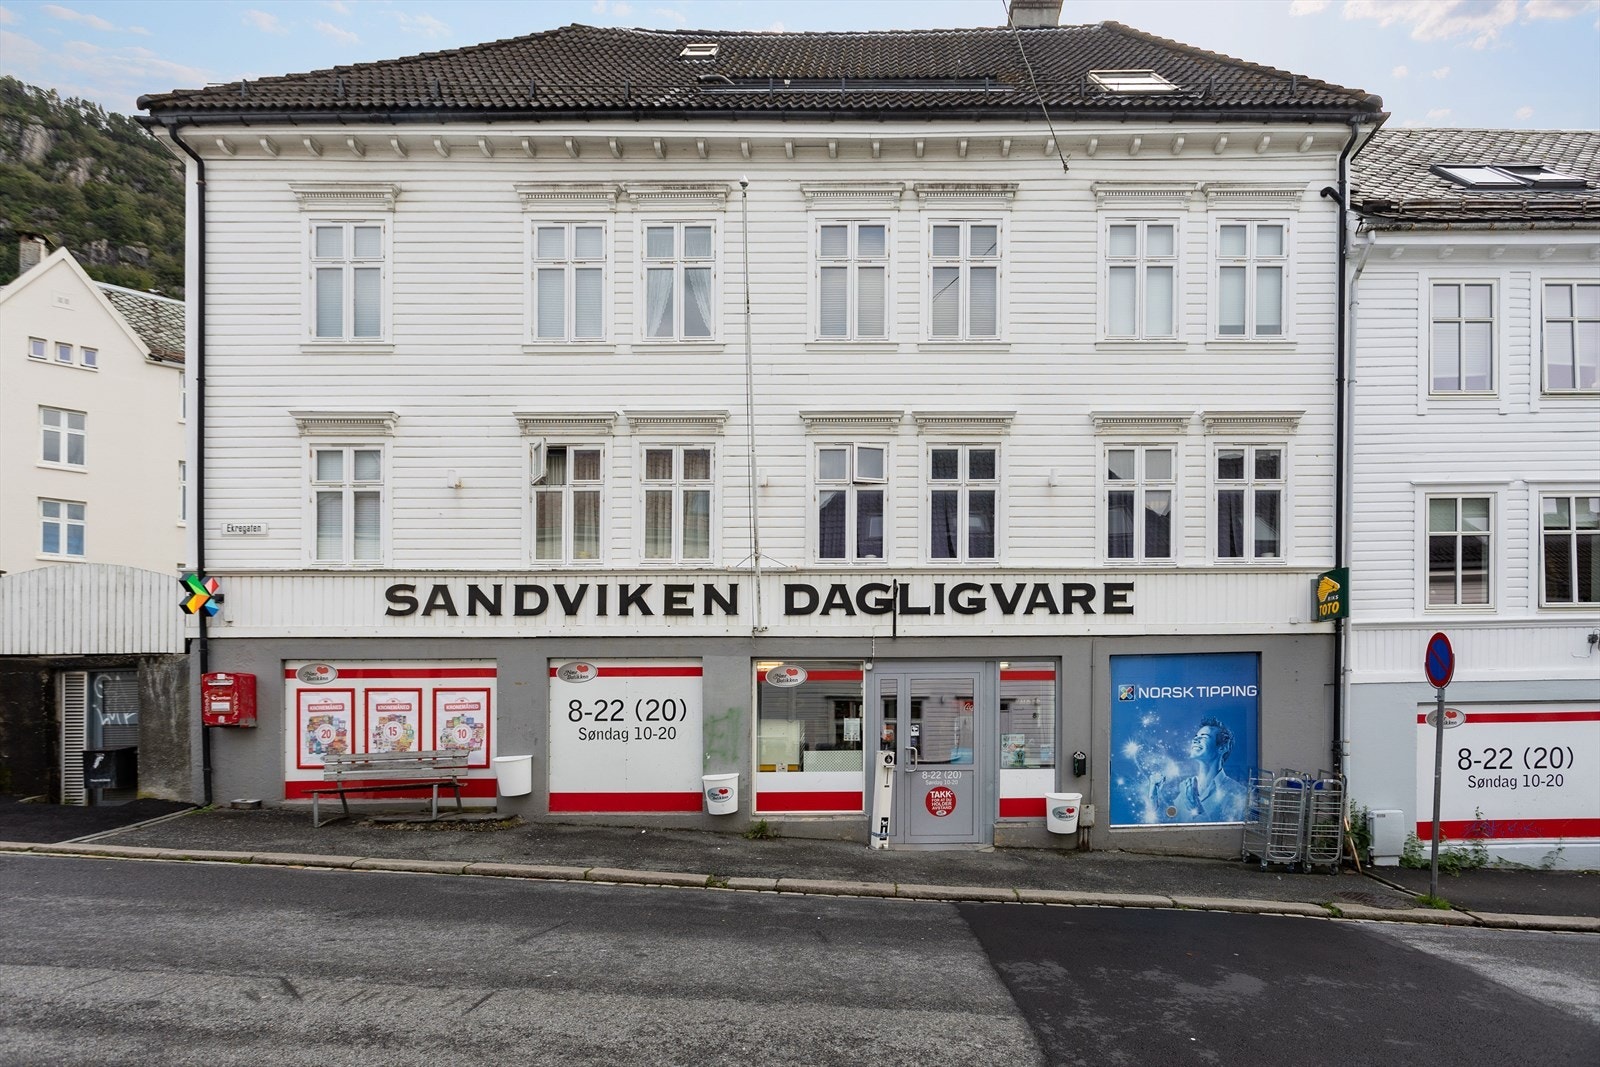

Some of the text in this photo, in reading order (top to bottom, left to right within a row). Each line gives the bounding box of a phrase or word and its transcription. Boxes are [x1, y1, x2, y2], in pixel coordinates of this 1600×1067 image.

[226, 523, 262, 535] Ekregaten
[385, 581, 1135, 616] SANDVIKEN DAGLIGVARE
[1319, 601, 1340, 616] TOTO
[1138, 685, 1257, 699] NORSK TIPPING
[568, 698, 687, 722] 8-22 (20)
[321, 729, 332, 739] 20
[388, 726, 398, 736] 15
[457, 729, 467, 739] 10
[578, 726, 677, 742] Søndag 10-20
[1457, 746, 1574, 770] 8-22 (20)
[921, 770, 962, 780] 8-22 (20)
[1467, 773, 1564, 790] Søndag 10-20
